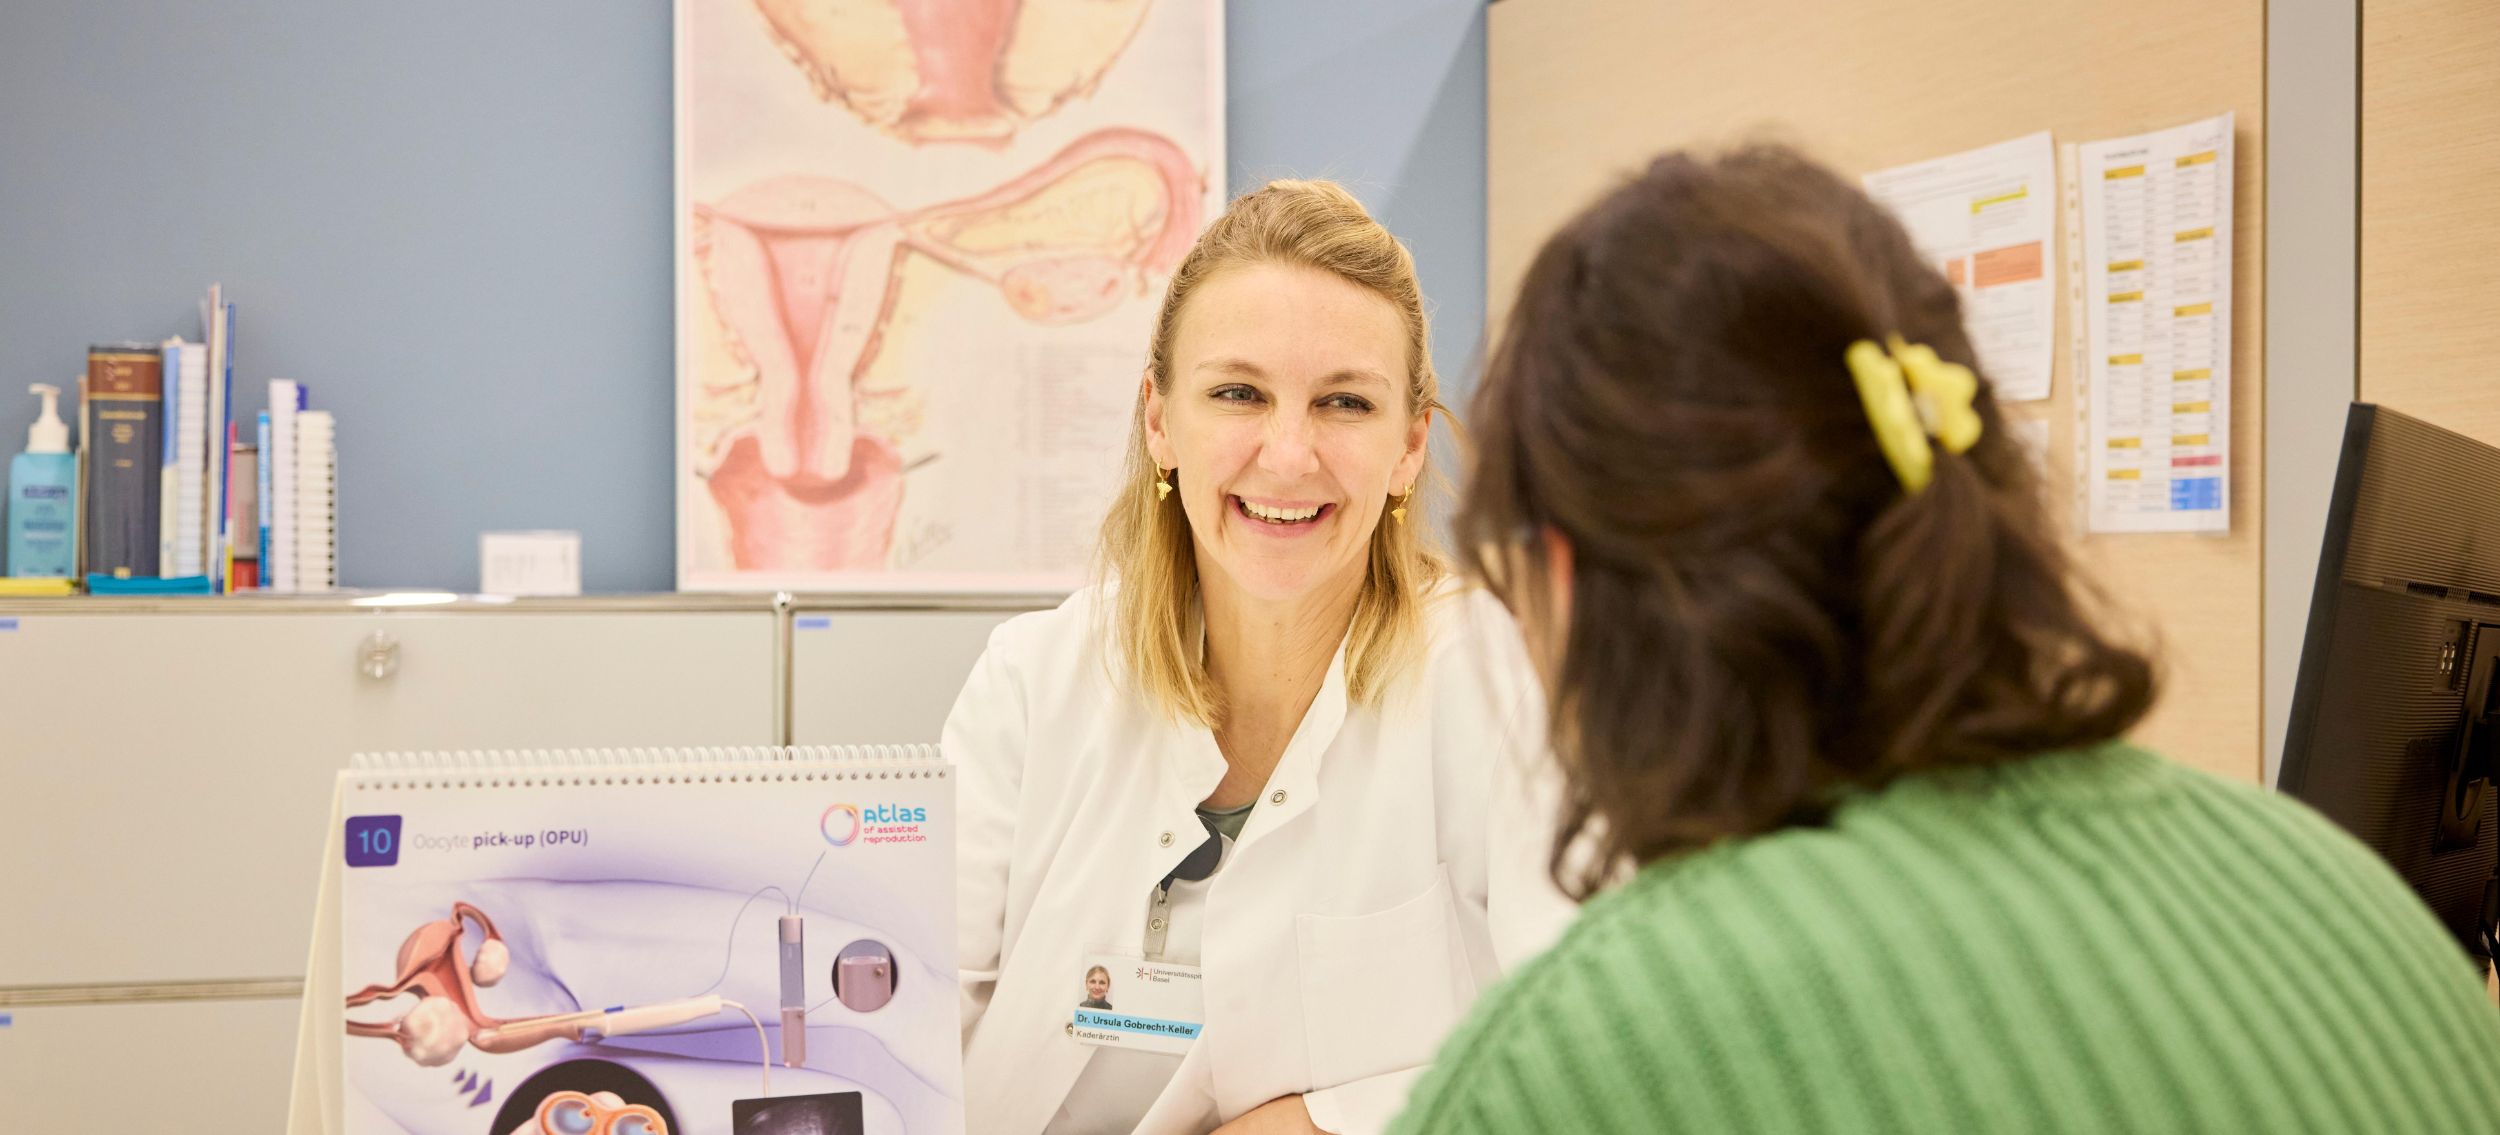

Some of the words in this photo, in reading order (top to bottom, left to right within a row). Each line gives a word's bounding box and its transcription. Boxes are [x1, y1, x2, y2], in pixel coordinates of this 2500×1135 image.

[863, 803, 926, 823] Atlas
[863, 826, 875, 834] of
[877, 825, 918, 833] assisted
[863, 834, 927, 845] reproduction
[357, 828, 392, 854] 10
[413, 832, 469, 852] Oocyte
[473, 831, 535, 850] pick-up
[540, 829, 588, 847] (OPU)
[1077, 1014, 1090, 1024] Dr.
[1093, 1016, 1121, 1027] Ursula
[1124, 1019, 1194, 1035] Gobrecht-Keller
[1076, 1030, 1120, 1042] Kaderärztin
